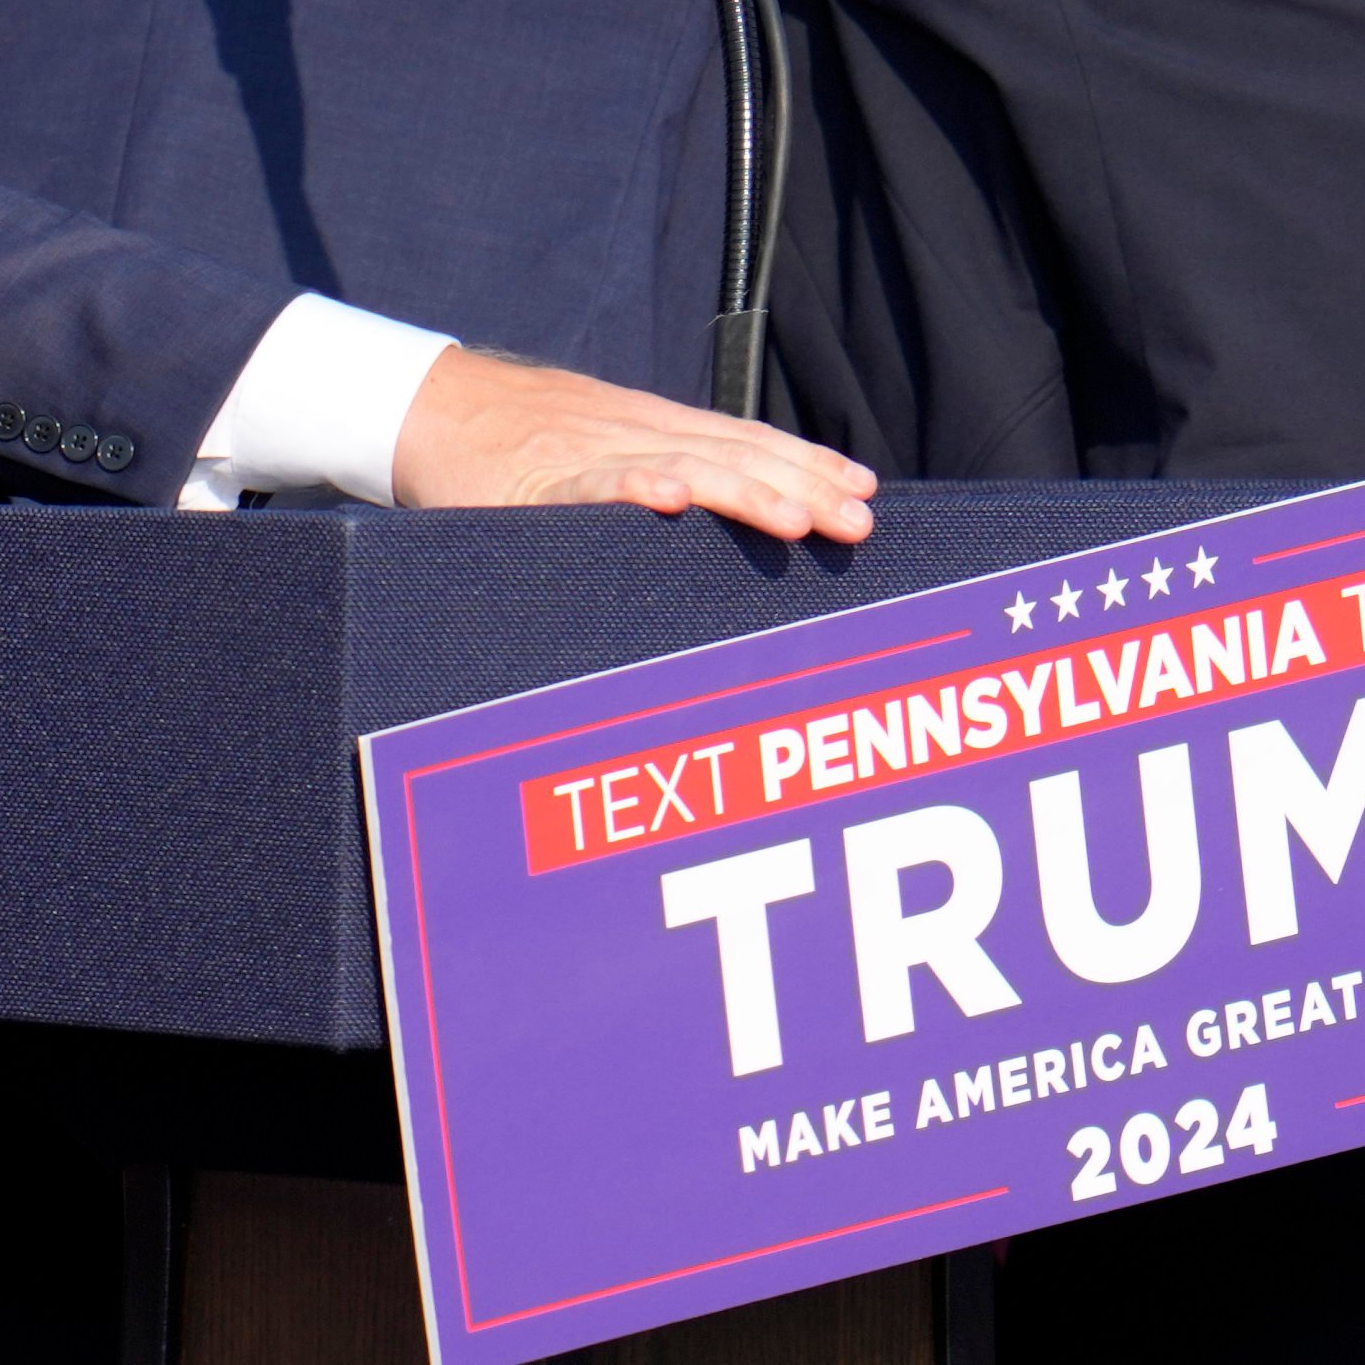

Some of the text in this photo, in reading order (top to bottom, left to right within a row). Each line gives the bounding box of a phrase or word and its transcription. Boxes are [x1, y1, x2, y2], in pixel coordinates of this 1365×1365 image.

[554, 742, 735, 850] TEXT
[759, 600, 1327, 802] PENNSYLVANIA
[738, 1090, 895, 1173] MAKE
[915, 1024, 1168, 1129] AMERICA
[1186, 971, 1363, 1057] GREAT
[1066, 1083, 1278, 1202] 2024
